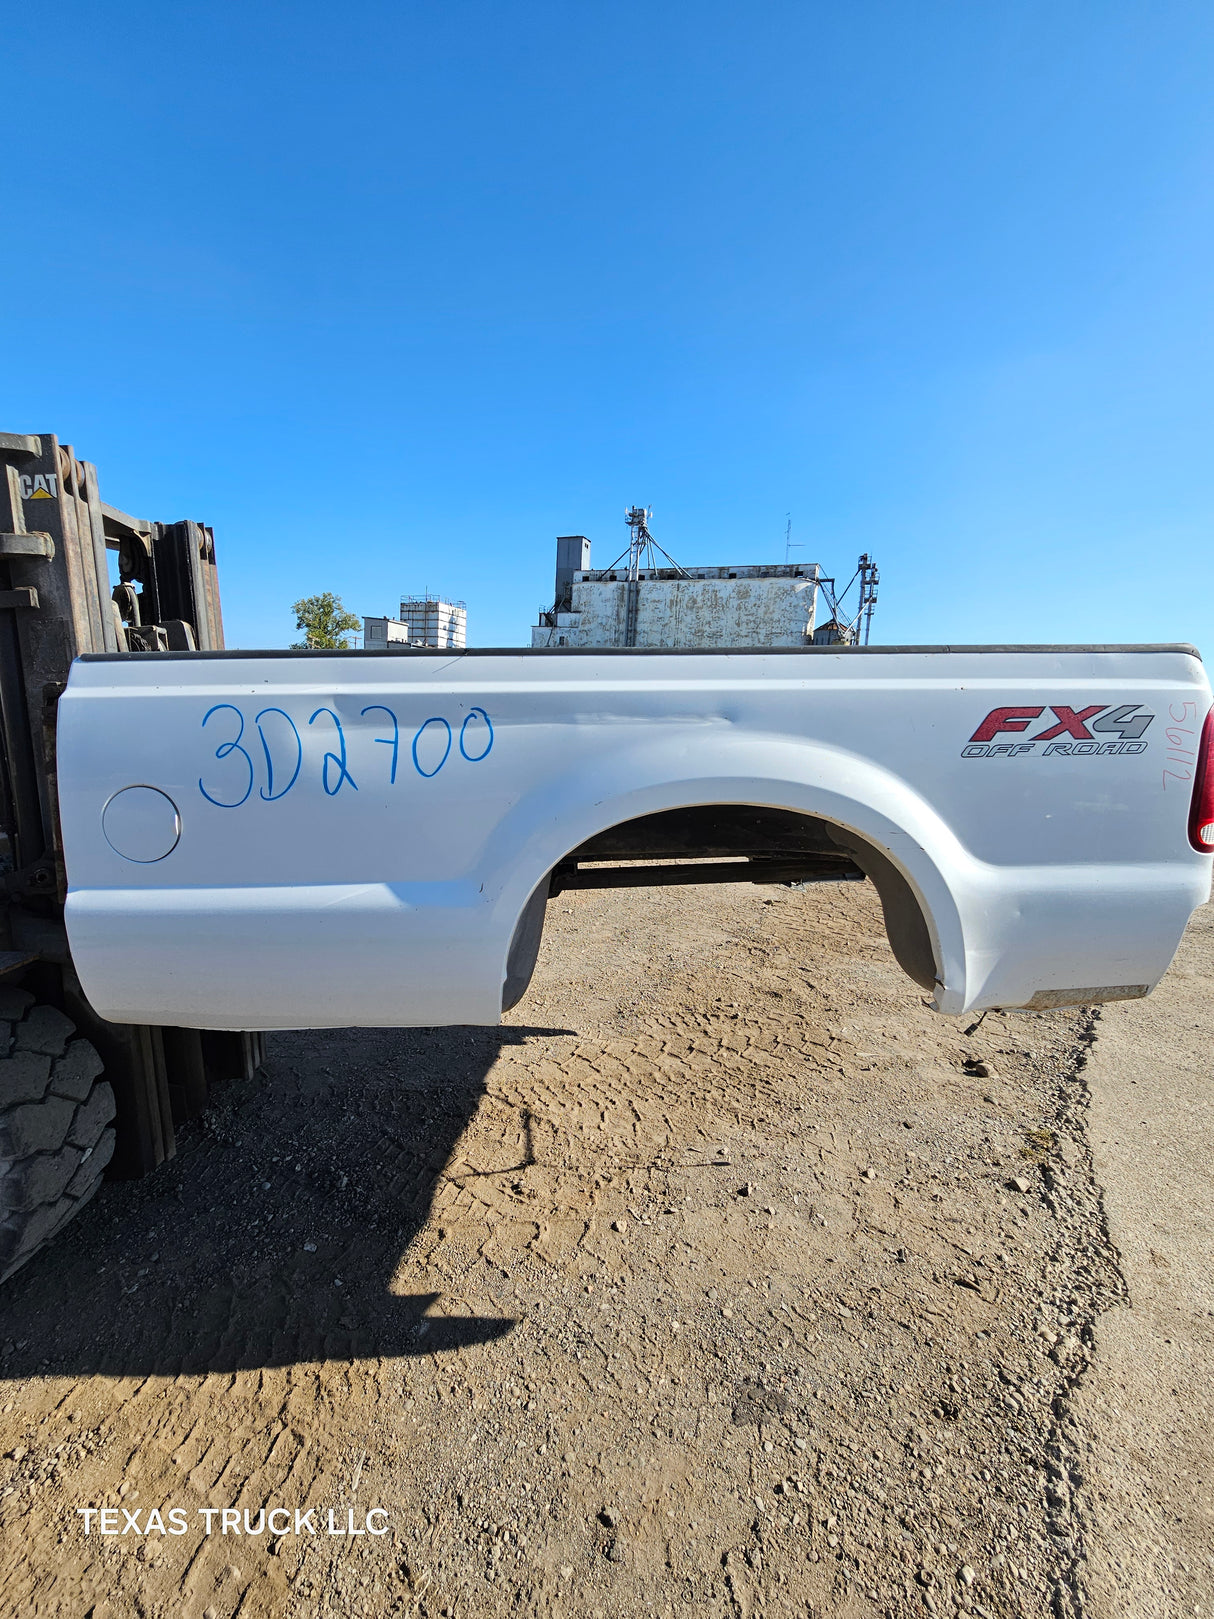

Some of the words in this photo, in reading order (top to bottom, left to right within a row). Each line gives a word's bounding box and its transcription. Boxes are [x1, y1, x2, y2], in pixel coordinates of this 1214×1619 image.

[21, 474, 57, 499] CAT
[968, 704, 1155, 742] FX4
[199, 704, 494, 808] 3D2700
[960, 743, 1035, 758] OFF
[1041, 741, 1149, 757] ROAD
